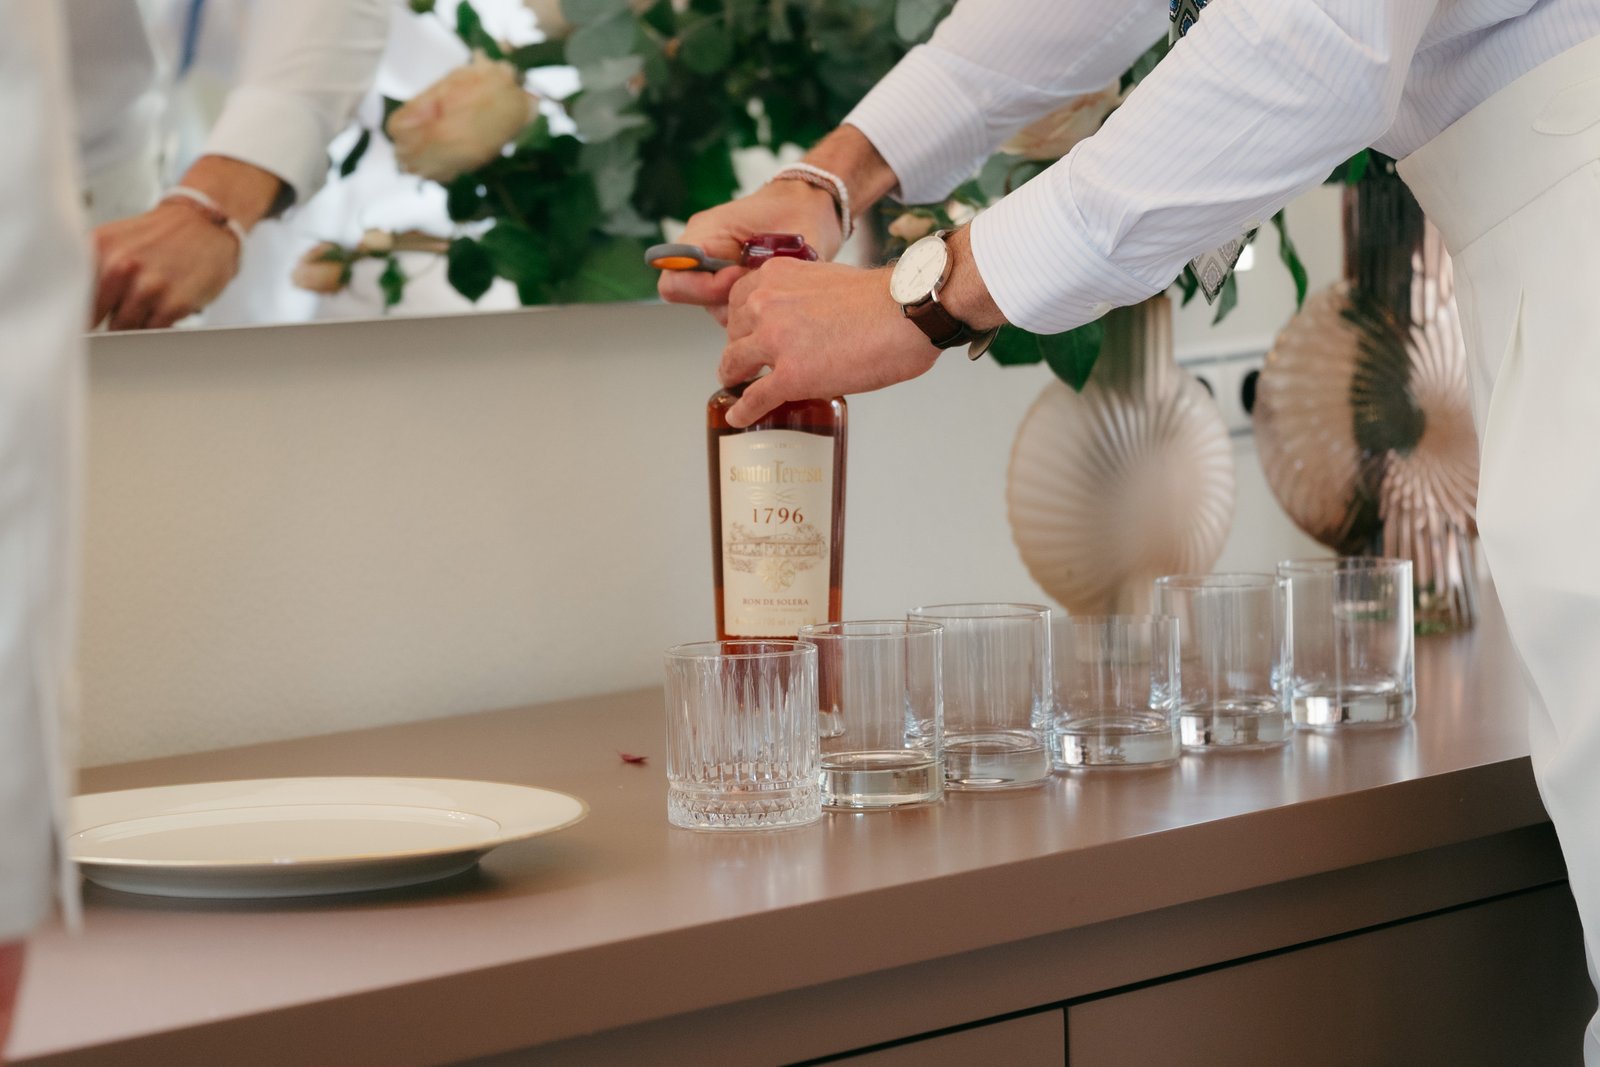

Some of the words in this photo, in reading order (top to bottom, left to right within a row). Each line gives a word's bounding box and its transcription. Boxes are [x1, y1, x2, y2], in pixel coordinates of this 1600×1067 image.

[753, 507, 804, 524] 1796
[742, 598, 761, 606] RON
[763, 598, 775, 606] DE
[777, 598, 809, 606] SOLERA
